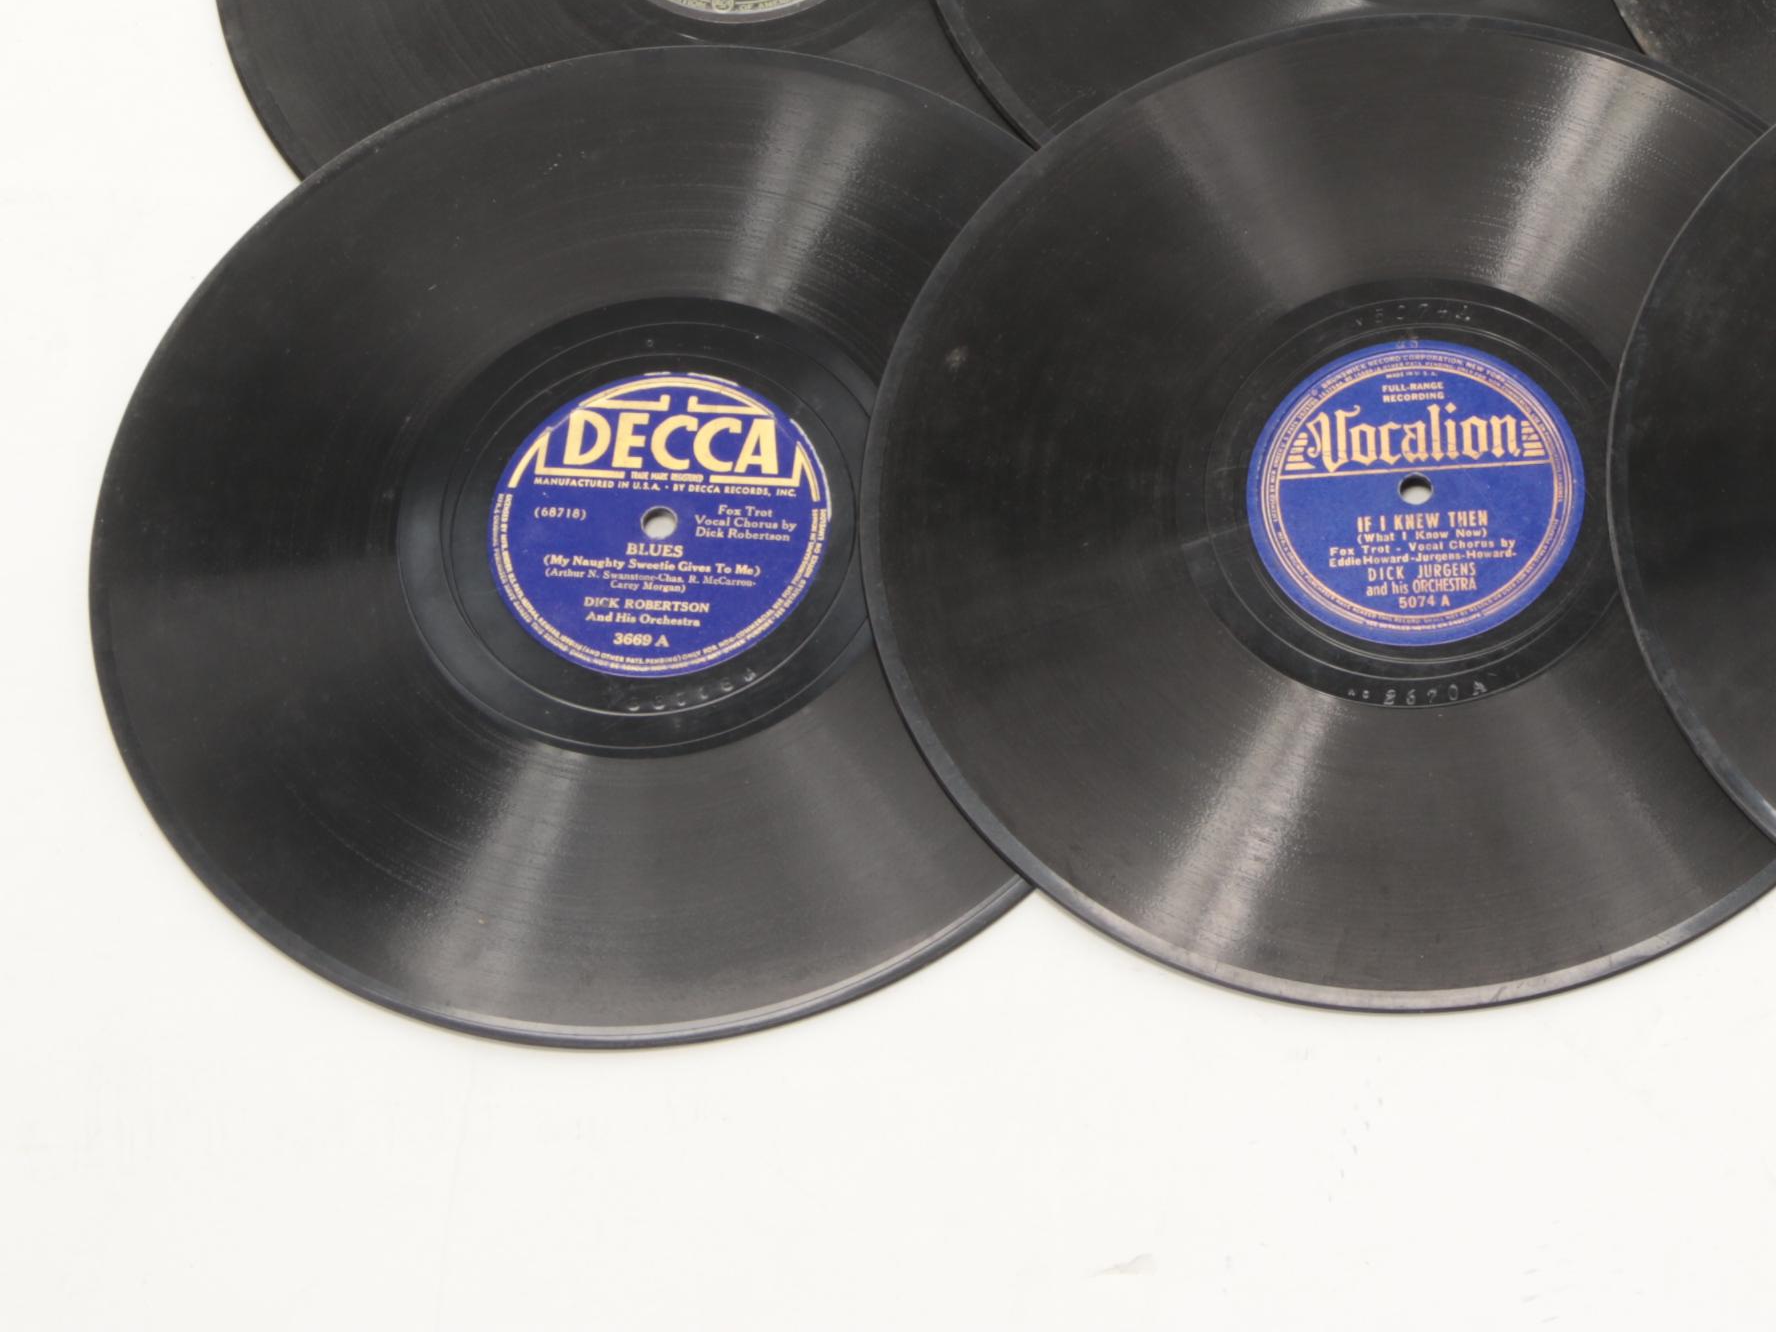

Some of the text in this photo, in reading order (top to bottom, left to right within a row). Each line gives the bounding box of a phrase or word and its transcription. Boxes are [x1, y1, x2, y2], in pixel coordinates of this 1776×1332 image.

[1382, 382, 1444, 402] FULL-RANGE RECORDING
[563, 409, 779, 474] DECCA
[1306, 402, 1520, 472] Vocalion
[534, 477, 614, 488] MANUFACTURED
[618, 480, 629, 488] IN
[673, 483, 685, 492] BY
[688, 484, 720, 494] DECCA
[776, 488, 797, 497] INC.
[535, 507, 587, 520] (68718)
[718, 505, 772, 517] Fox Trot
[695, 515, 797, 532] Vocal Chorus by
[1357, 510, 1488, 532] IF I KNEW THEN
[696, 526, 790, 541] Dick Robertson
[1357, 533, 1395, 544] (What
[1415, 531, 1448, 540] Know
[1456, 528, 1487, 538] Now)
[626, 542, 683, 558] BLUES
[543, 555, 761, 576] (My Naughty Sweetie Gives To Me)
[1368, 562, 1476, 581] DICK JURGENS
[1367, 577, 1477, 596] and his ORCHESTRA
[584, 597, 709, 613] DICK ROBERTSON
[1399, 595, 1450, 608] 5074 A
[586, 612, 700, 627] And His Orchestra
[613, 632, 669, 647] 3669 A
